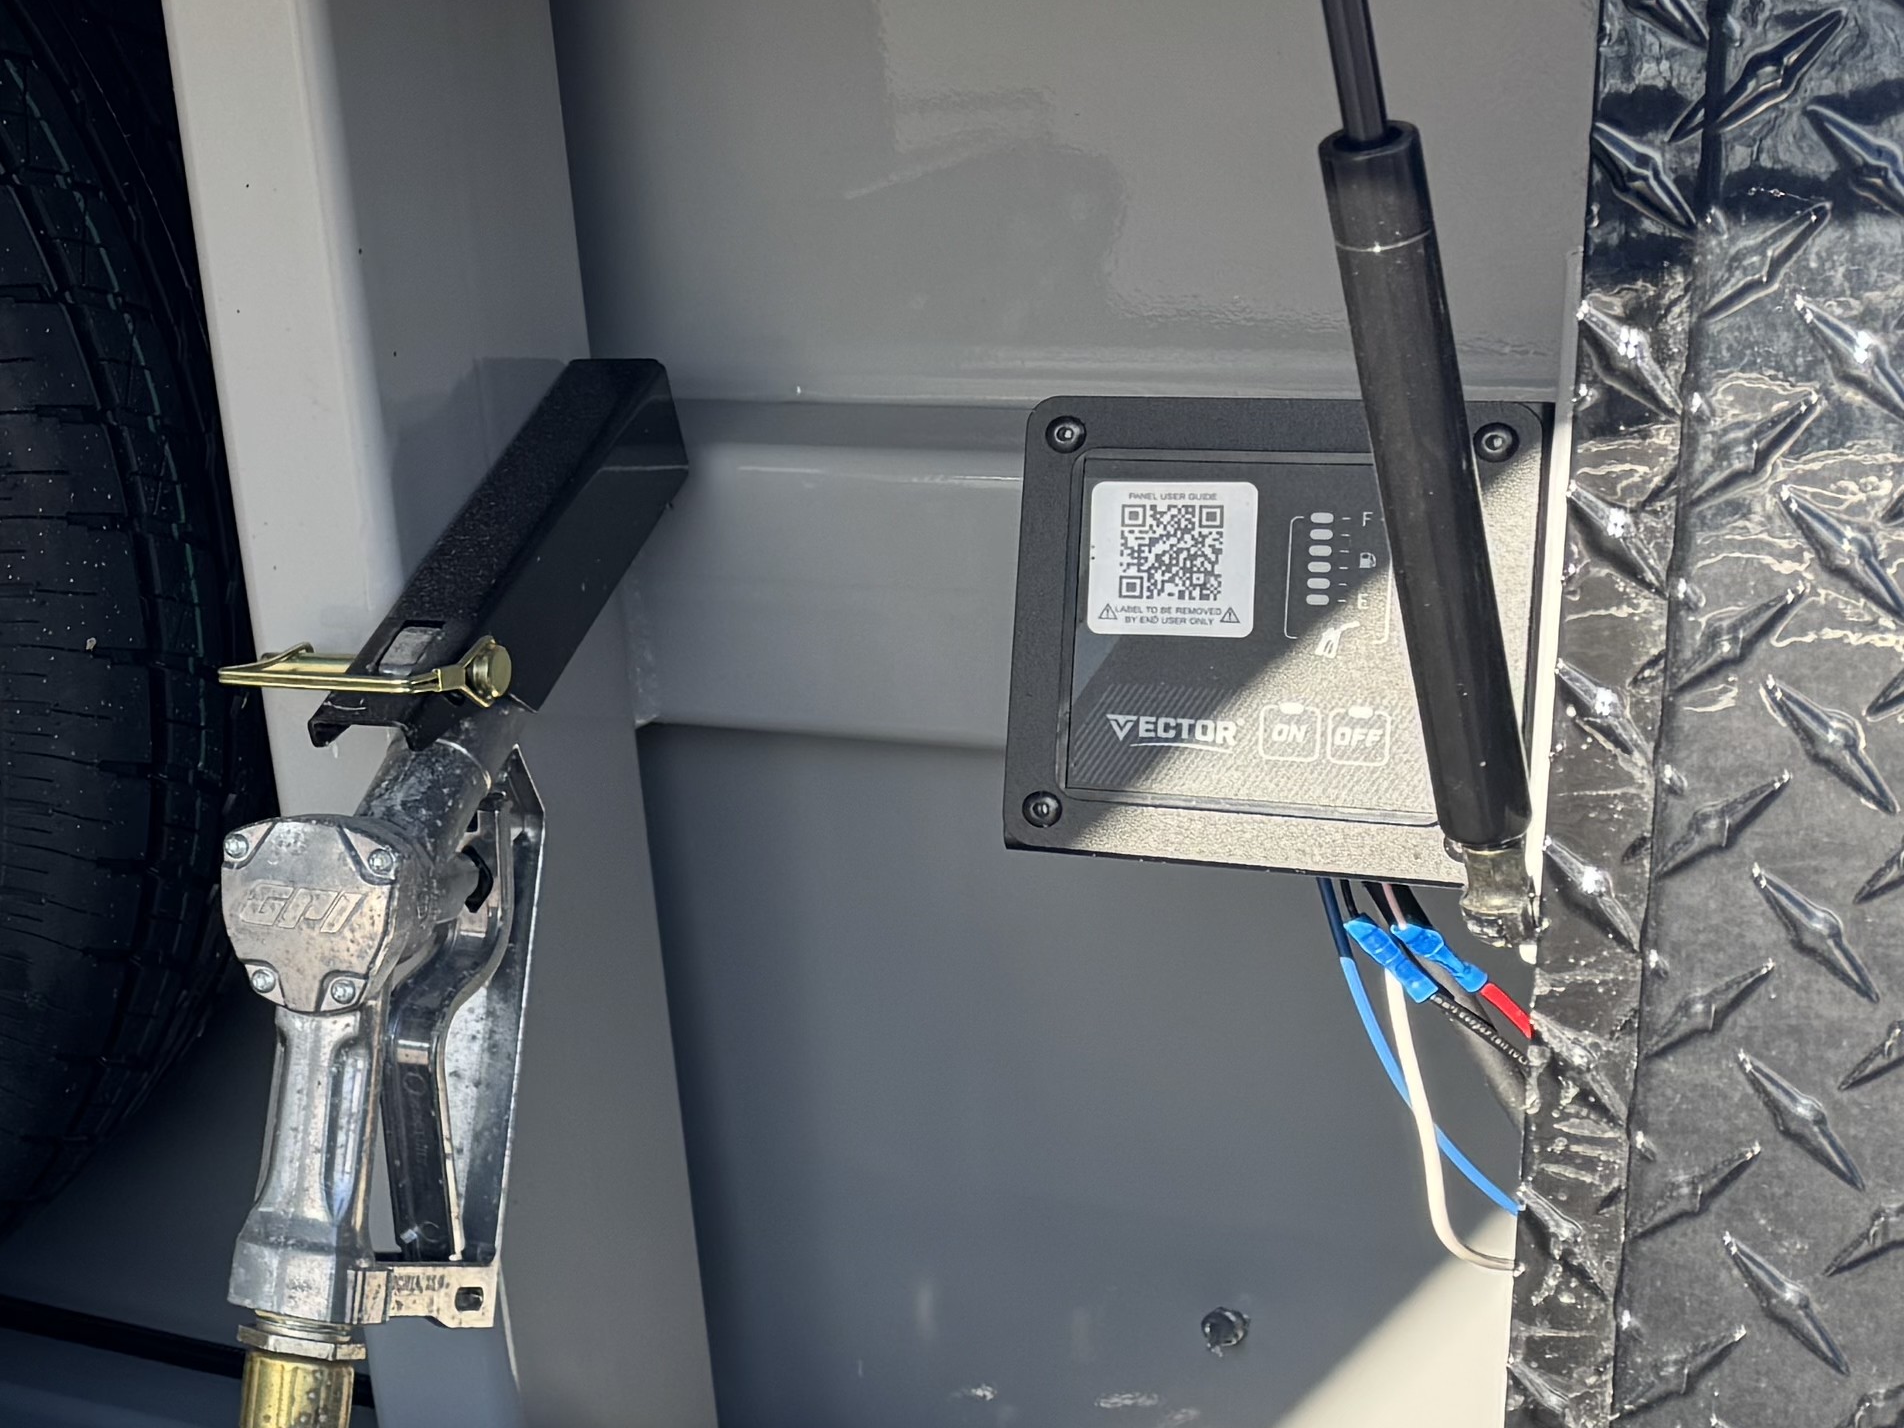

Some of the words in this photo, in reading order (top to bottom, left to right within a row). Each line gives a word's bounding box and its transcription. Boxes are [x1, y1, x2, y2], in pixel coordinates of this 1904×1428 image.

[1128, 492, 1158, 501] PANEL
[1160, 492, 1186, 501] USER
[1188, 492, 1218, 501] GUIDE
[1362, 511, 1374, 527] F
[1357, 593, 1370, 610] E
[1115, 605, 1143, 615] LABEL
[1146, 606, 1158, 614] TO
[1160, 606, 1172, 615] BE
[1175, 607, 1222, 616] REMOVED
[1124, 615, 1137, 624] BY
[1139, 615, 1159, 624] END
[1161, 616, 1189, 625] USER
[1189, 617, 1215, 626] ONLY
[1106, 713, 1238, 745] VECTOR
[1272, 723, 1308, 744] ON
[1333, 726, 1384, 748] OFF
[239, 879, 367, 934] GPI
